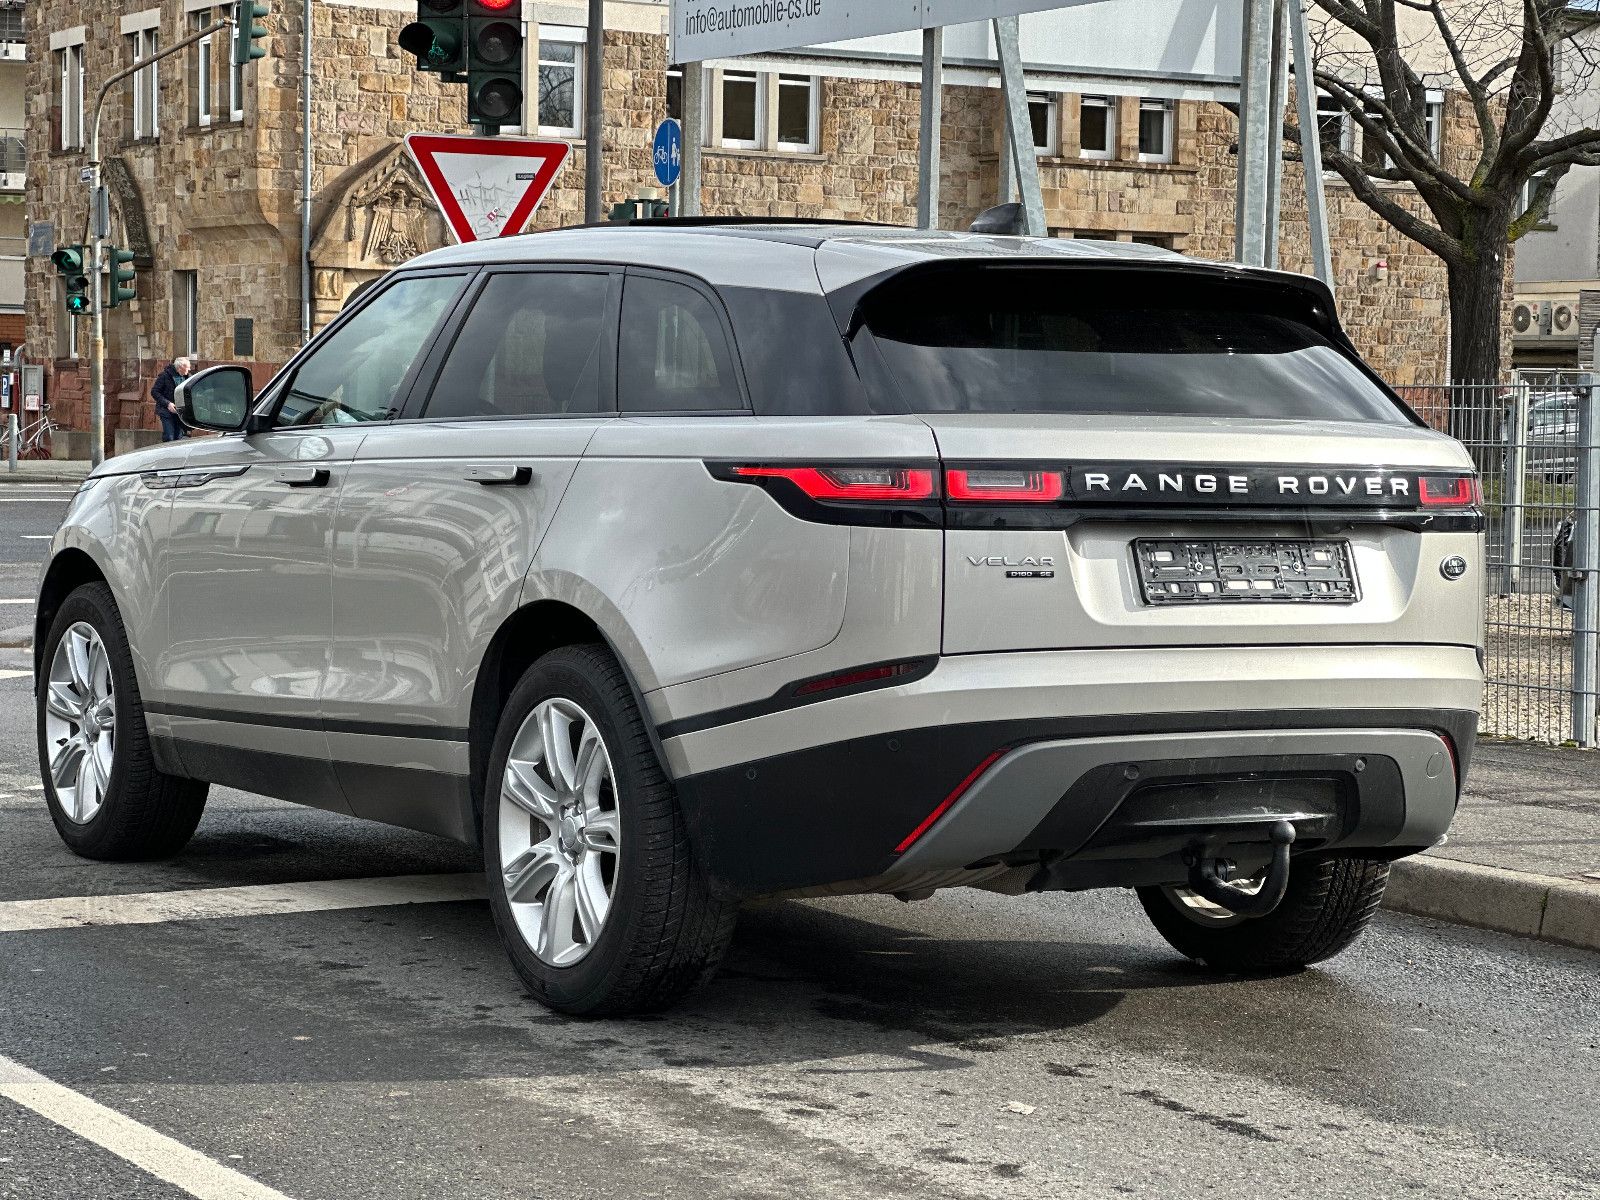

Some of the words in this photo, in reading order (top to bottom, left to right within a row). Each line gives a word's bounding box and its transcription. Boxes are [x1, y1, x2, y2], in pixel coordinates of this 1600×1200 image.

[686, 0, 821, 35] info@automobile-cs.de
[1084, 473, 1249, 494] RANGE
[1278, 476, 1410, 496] ROVER
[967, 556, 1054, 566] VELAR
